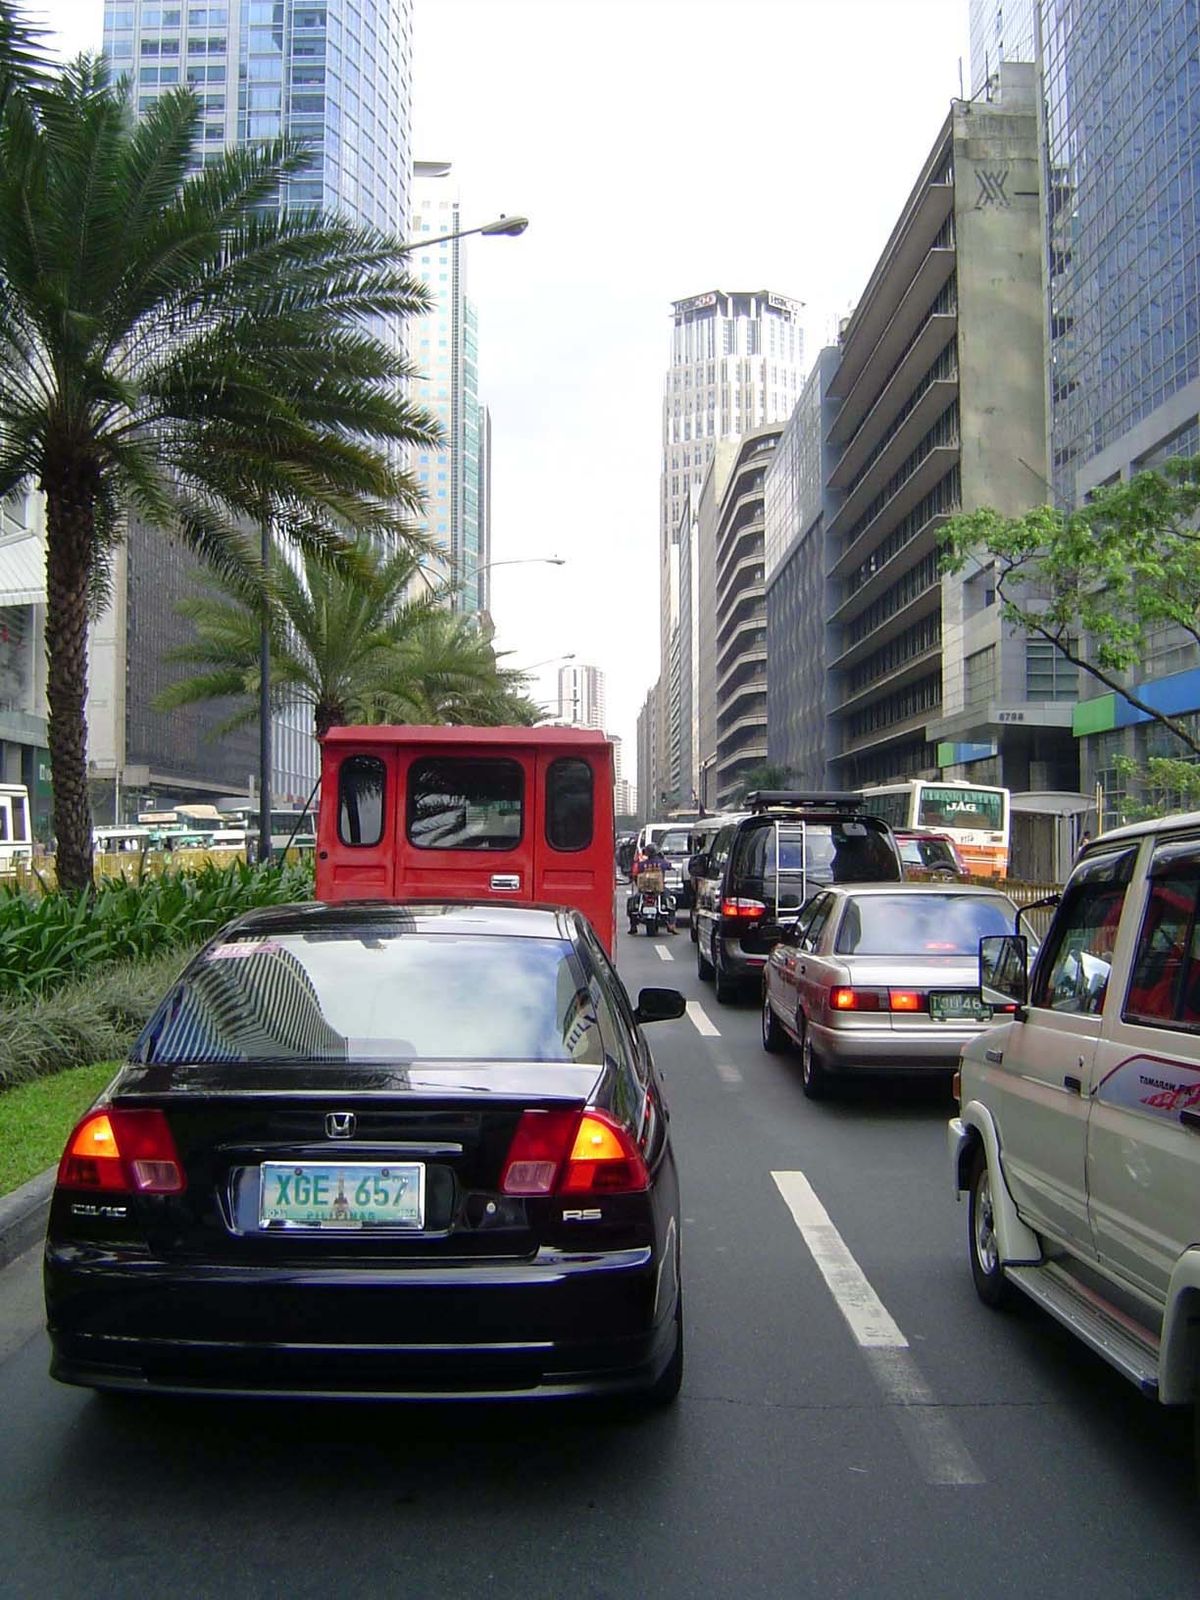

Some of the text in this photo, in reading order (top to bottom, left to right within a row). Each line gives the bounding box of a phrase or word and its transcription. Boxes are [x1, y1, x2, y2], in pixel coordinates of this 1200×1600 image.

[946, 801, 976, 812] JAG
[276, 1174, 409, 1207] XGE 657
[563, 1208, 602, 1221] RS
